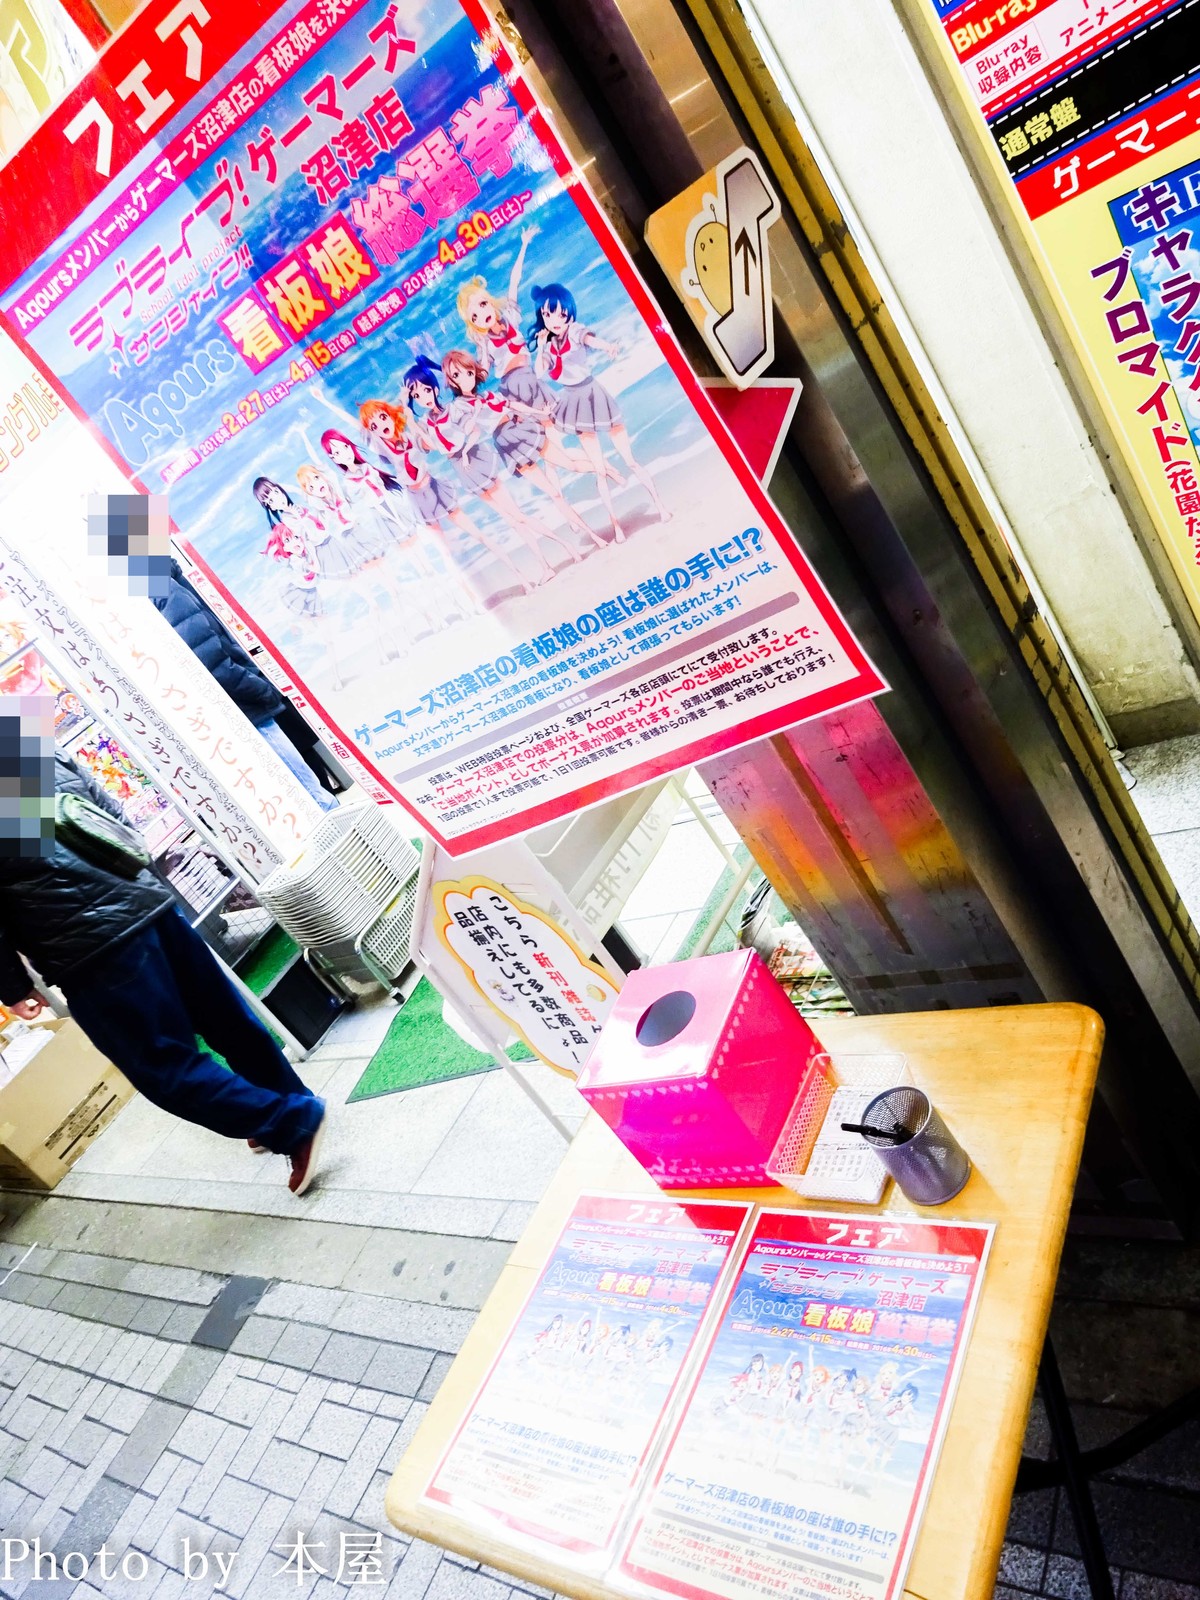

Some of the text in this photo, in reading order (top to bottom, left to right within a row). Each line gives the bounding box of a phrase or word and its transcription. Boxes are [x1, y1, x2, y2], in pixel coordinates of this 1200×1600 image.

[1060, 0, 1138, 47] アニメー
[976, 34, 1029, 75] Blu-ray
[978, 44, 1043, 95] 収録内容
[62, 0, 212, 178] フェア
[247, 3, 416, 185] ゲーマーズ
[301, 86, 415, 206] 沼津店
[999, 97, 1082, 161] 通常盤
[13, 0, 358, 330] Aqoursメンバーからゲーマーズ沼津店の看板娘を決
[222, 84, 518, 364] 看板娘 総選挙
[104, 339, 235, 466] Aqours
[354, 527, 762, 745] ゲーマーズ沼津店の看板娘の座は誰の手に!?
[0, 562, 262, 865] 注文はうさぎですか?
[467, 905, 588, 1044] 店内にも多数商品
[626, 1204, 686, 1224] フェア
[826, 1223, 903, 1249] フェア
[598, 1271, 653, 1297] 看板娘
[655, 1259, 693, 1276] 沼津店
[868, 1271, 946, 1295] ゲーマーズ
[730, 1288, 803, 1321] Aqours
[803, 1302, 877, 1335] 看板娘
[877, 1290, 927, 1312] 沼津店
